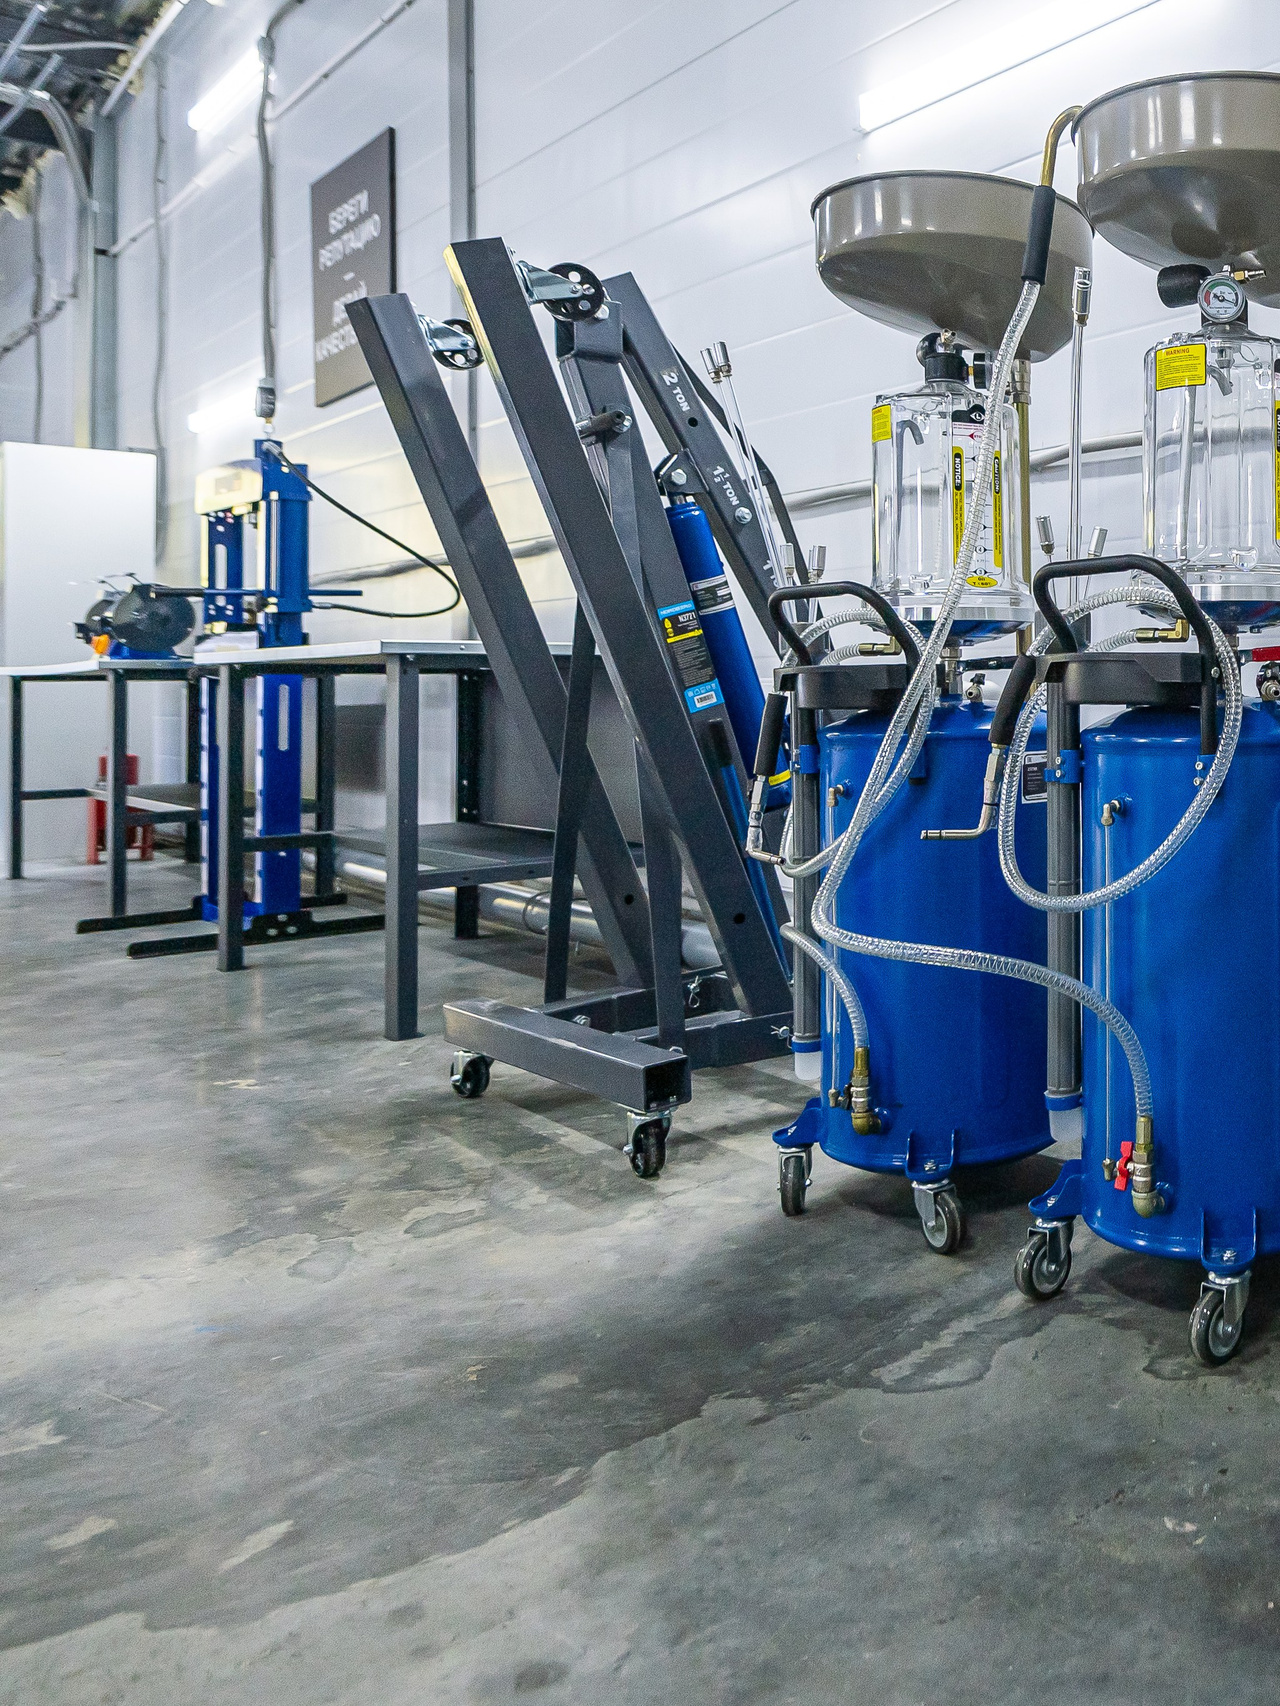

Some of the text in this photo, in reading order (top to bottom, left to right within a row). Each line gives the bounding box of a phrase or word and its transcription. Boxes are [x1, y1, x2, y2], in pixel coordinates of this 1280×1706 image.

[1166, 347, 1190, 356] WARNING
[662, 372, 690, 412] 2 TON
[722, 483, 740, 506] TON
